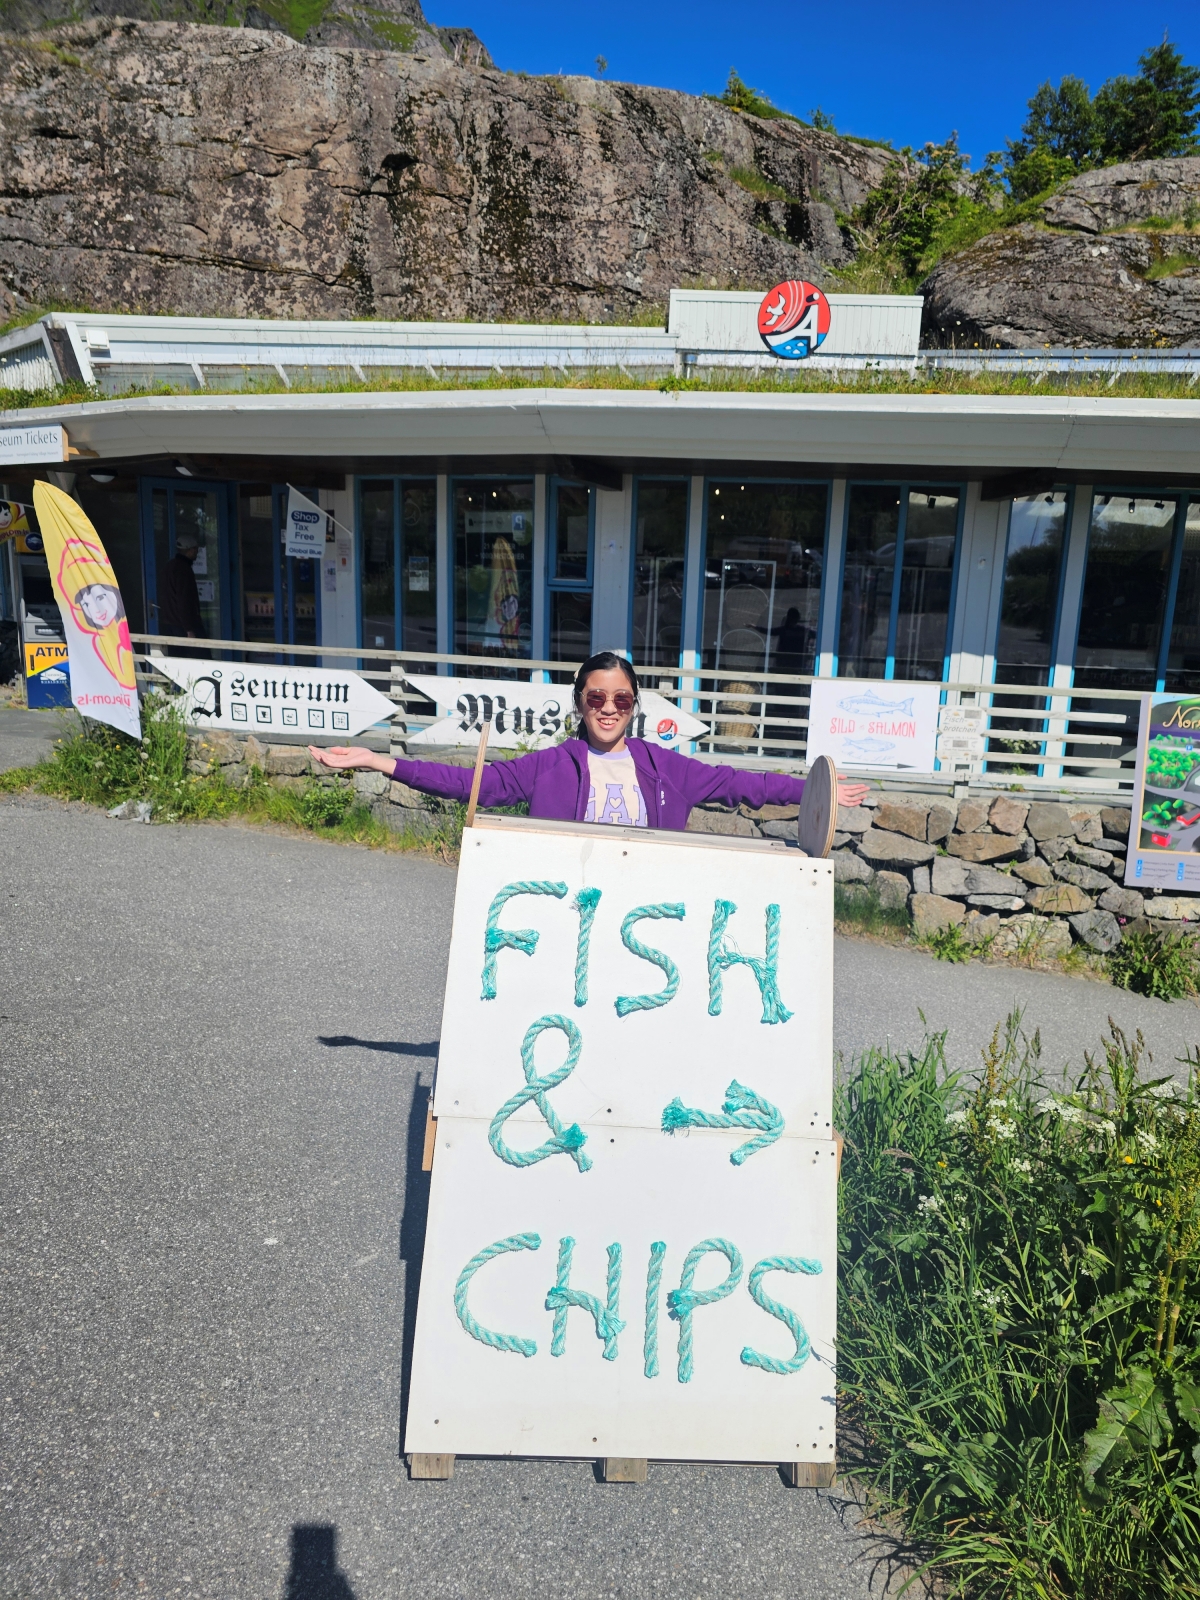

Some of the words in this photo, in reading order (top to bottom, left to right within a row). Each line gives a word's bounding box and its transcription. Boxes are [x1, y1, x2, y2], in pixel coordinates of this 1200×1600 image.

[25, 430, 58, 445] Tickets
[293, 511, 318, 523] Shop
[294, 522, 309, 531] Tax
[295, 531, 315, 540] Free
[289, 547, 308, 555] Global
[35, 647, 69, 657] ATM
[190, 670, 223, 720] Å
[230, 671, 350, 703] sentrum
[829, 717, 856, 734] SILD
[868, 721, 917, 738] SALMON
[480, 880, 795, 1024] FISH
[488, 1014, 593, 1173] &
[454, 1232, 823, 1383] CHIPS
